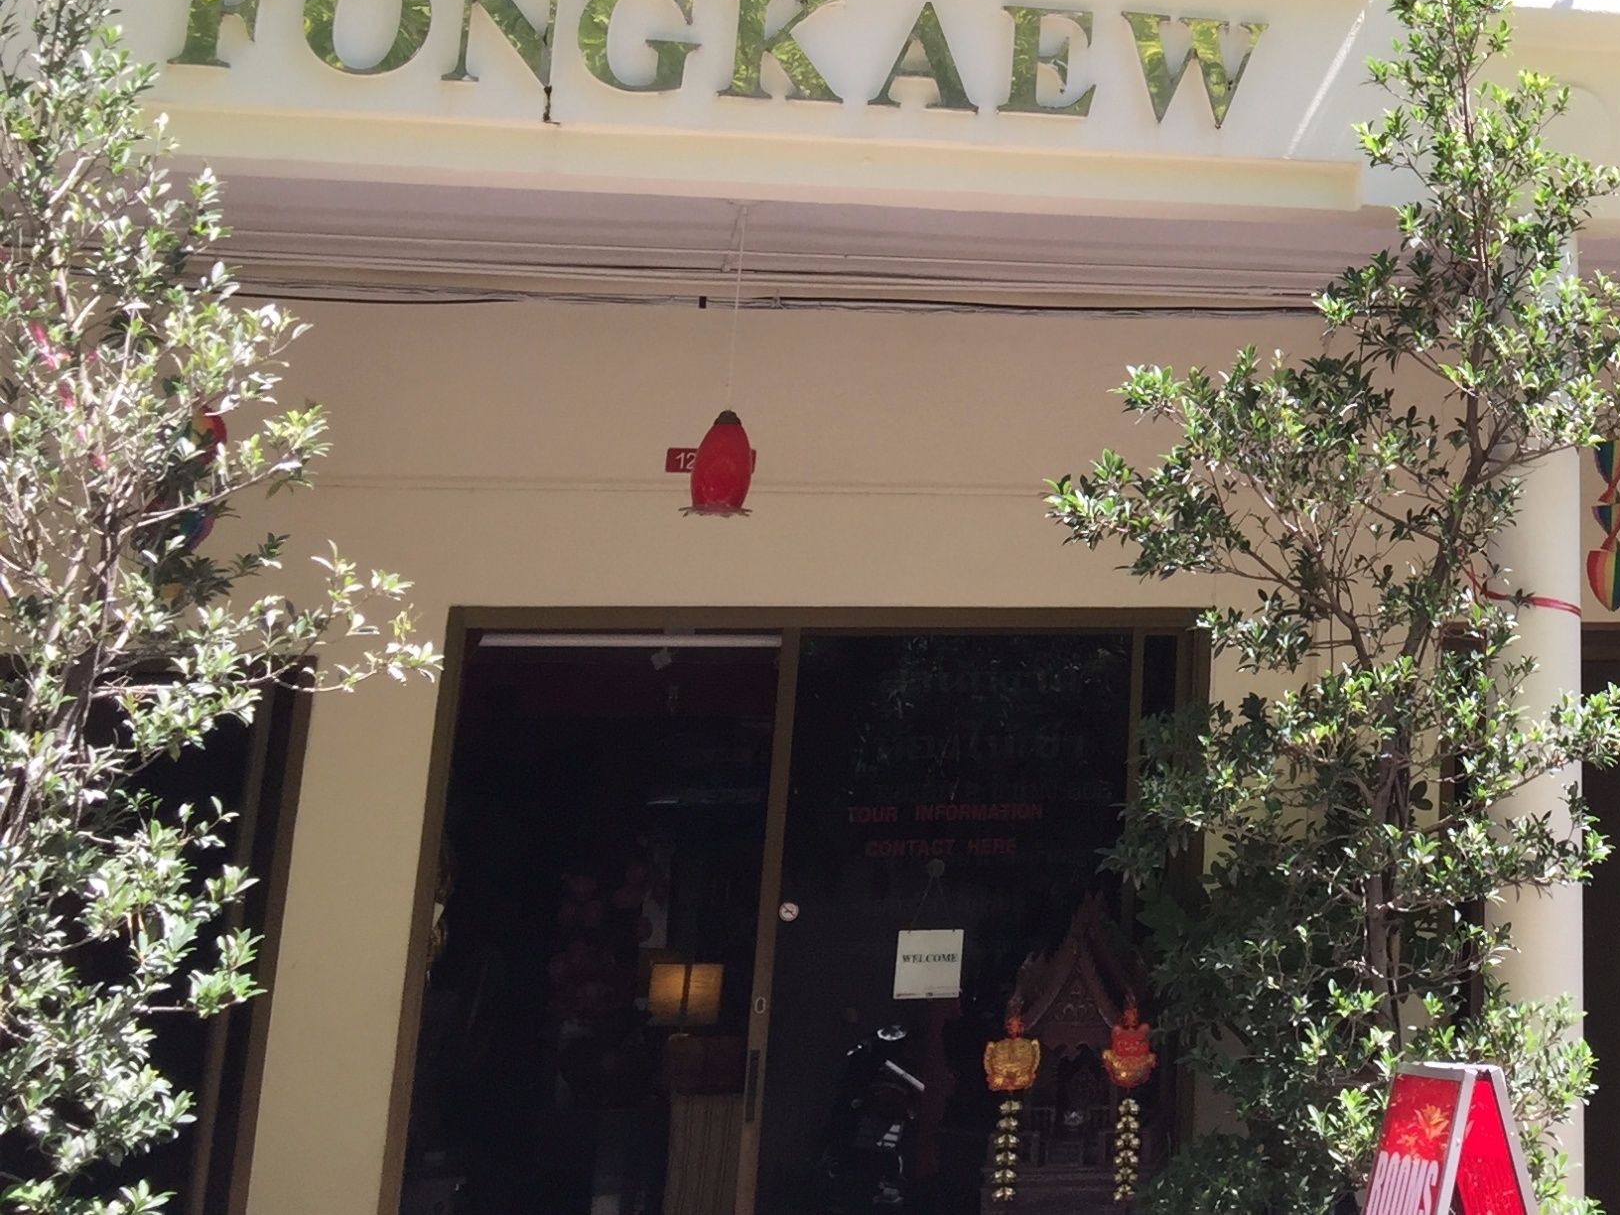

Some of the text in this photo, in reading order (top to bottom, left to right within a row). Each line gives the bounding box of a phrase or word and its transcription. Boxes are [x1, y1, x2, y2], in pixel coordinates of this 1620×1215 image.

[849, 802, 1043, 823] TOUR INFORMATION
[864, 838, 956, 857] CONTACT
[967, 837, 1018, 855] HERE
[902, 953, 958, 963] WELCOME
